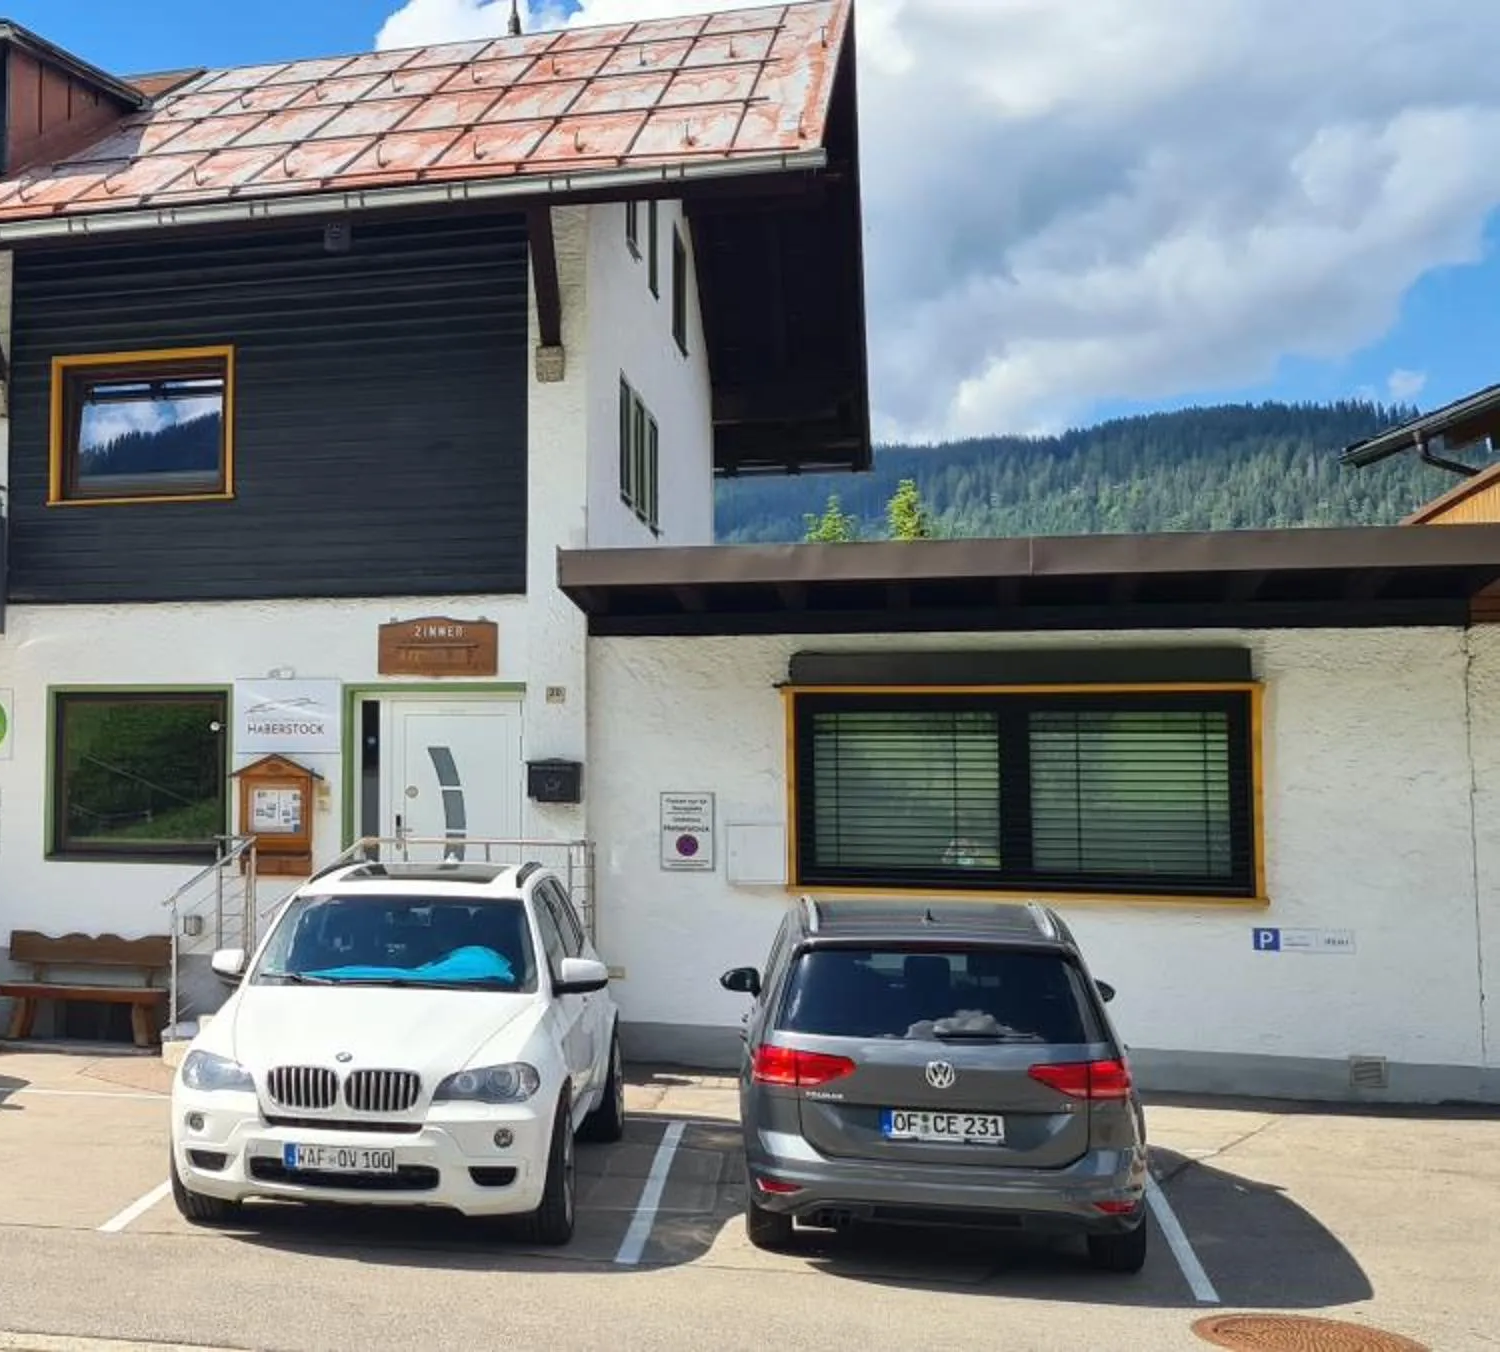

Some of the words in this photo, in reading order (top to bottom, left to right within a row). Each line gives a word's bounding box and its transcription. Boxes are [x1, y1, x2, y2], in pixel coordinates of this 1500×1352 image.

[247, 723, 325, 735] HABERSTOCK
[1260, 931, 1273, 949] P
[894, 1113, 918, 1132] OF
[933, 1115, 958, 1134] CE
[963, 1117, 1002, 1136] 231
[362, 1151, 391, 1169] 100
